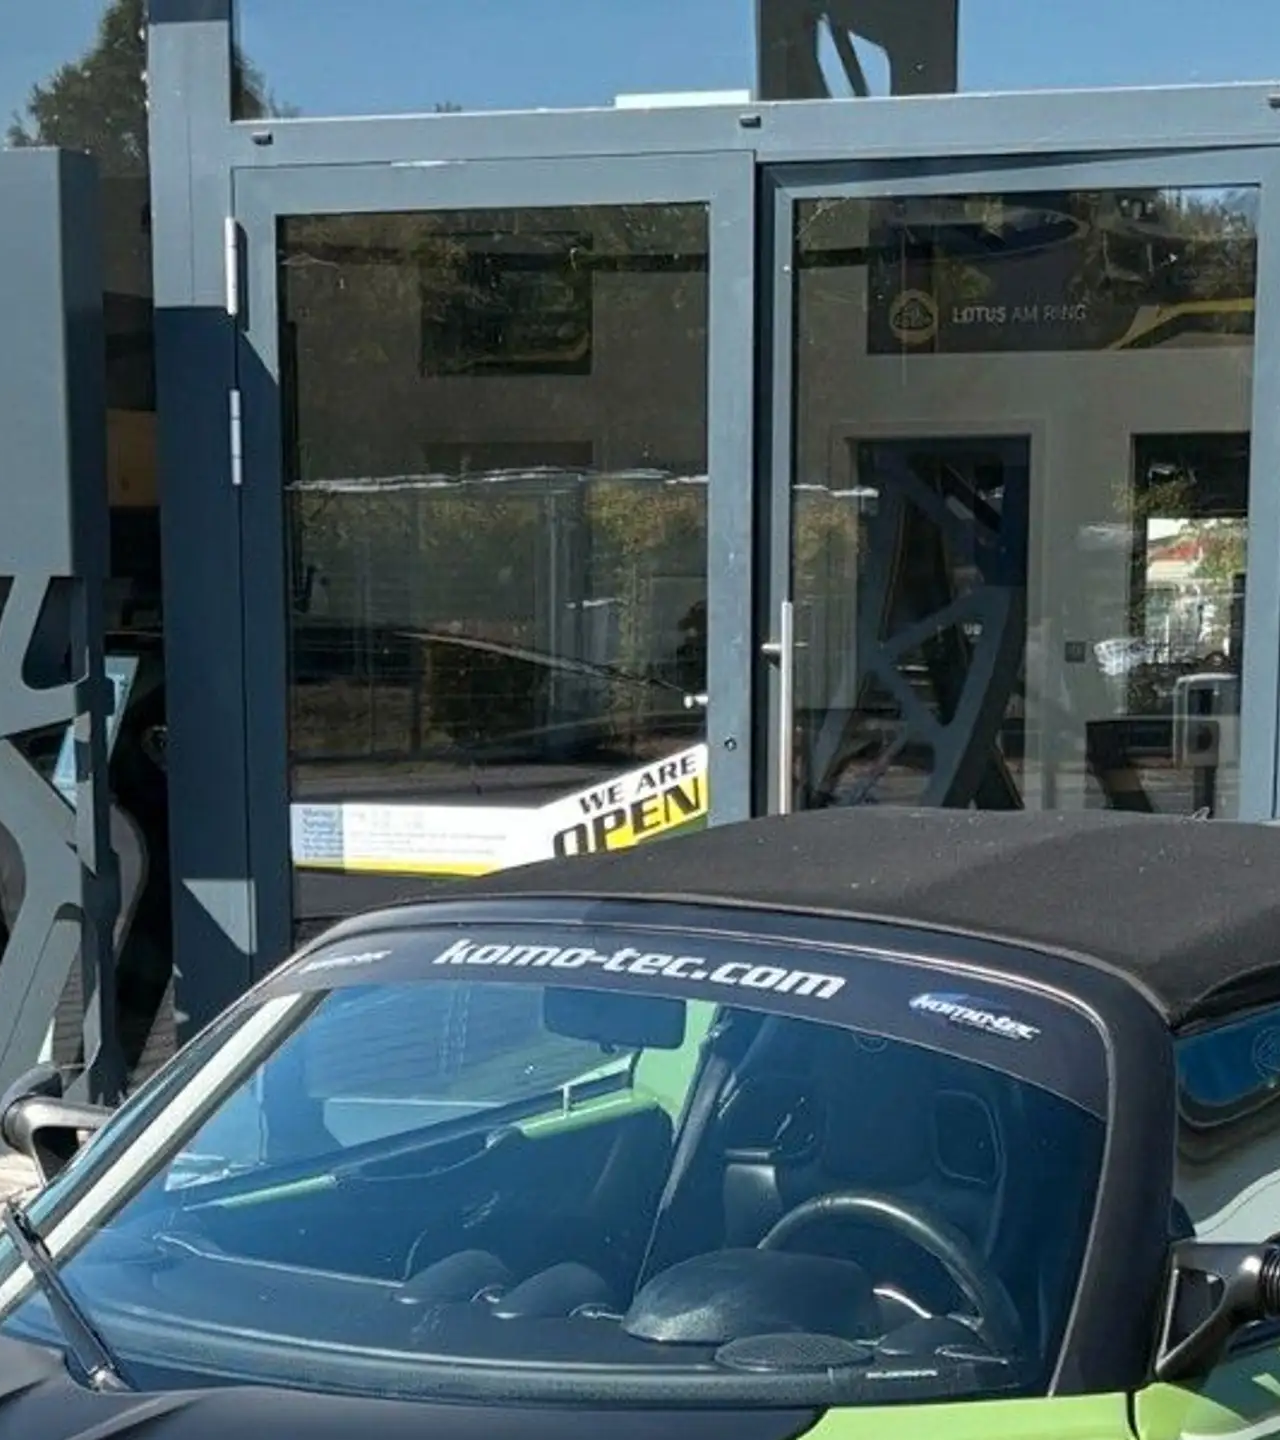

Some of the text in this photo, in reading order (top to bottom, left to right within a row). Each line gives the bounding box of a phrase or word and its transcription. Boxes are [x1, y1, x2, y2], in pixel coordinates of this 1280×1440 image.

[952, 306, 1006, 324] LOTUS
[577, 752, 698, 816] WE ARE
[552, 777, 701, 858] OPEN
[434, 937, 846, 1000] komo-tec.com
